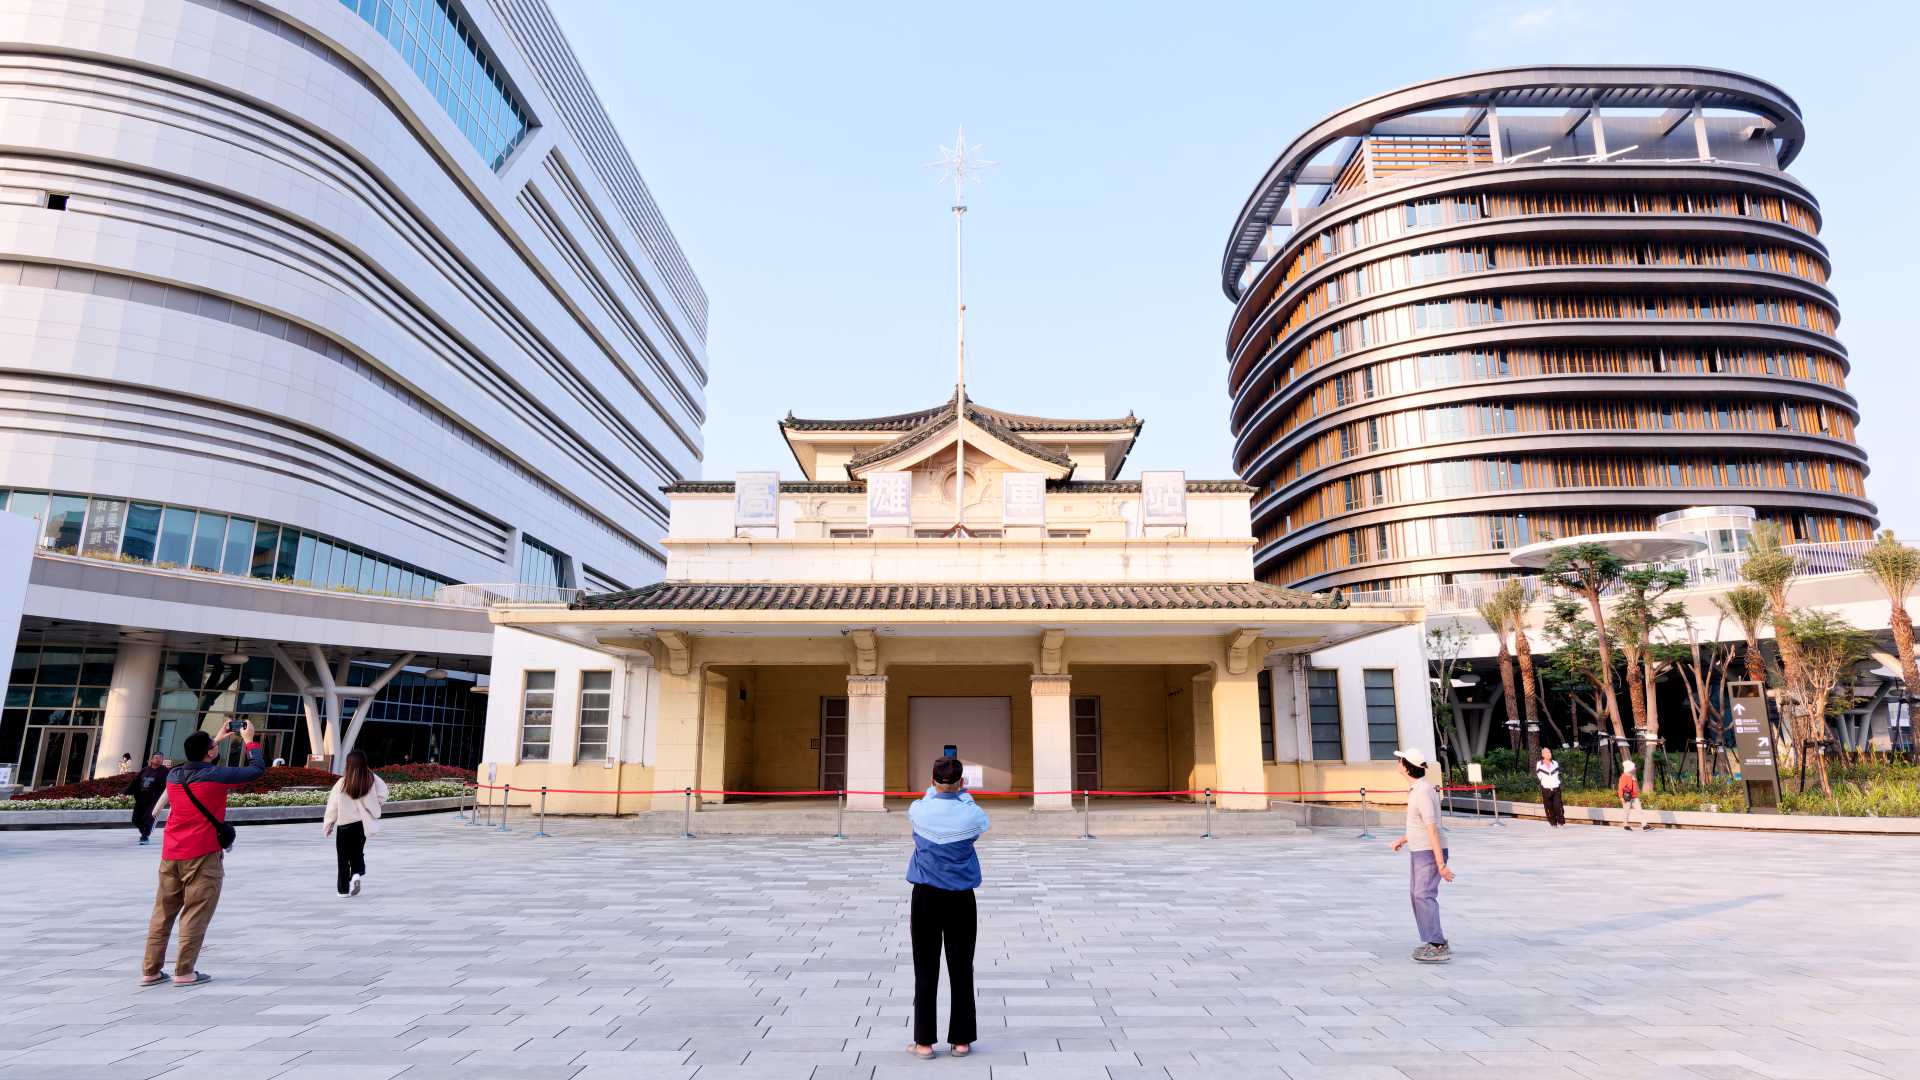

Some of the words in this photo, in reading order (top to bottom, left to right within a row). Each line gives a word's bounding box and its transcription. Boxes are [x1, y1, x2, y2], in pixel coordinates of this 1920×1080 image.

[870, 477, 907, 513] 雄
[1007, 477, 1041, 514] 車
[1146, 478, 1182, 514] 站
